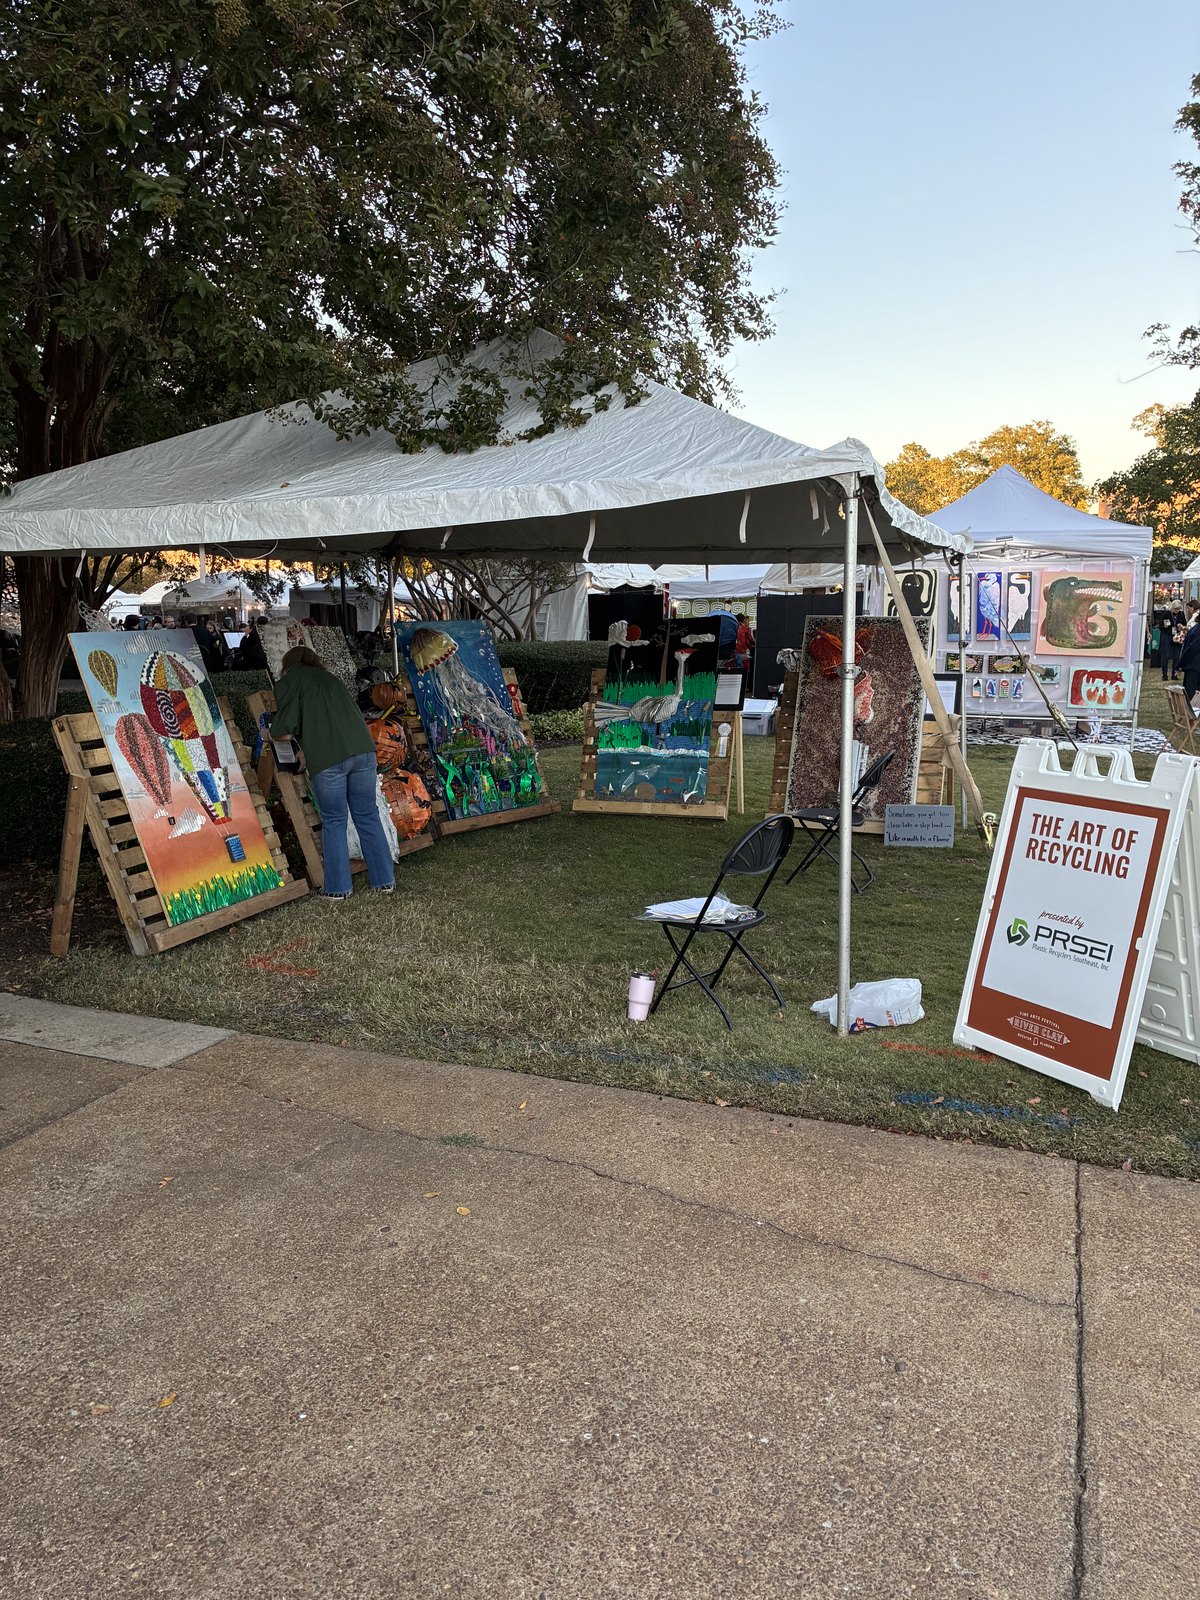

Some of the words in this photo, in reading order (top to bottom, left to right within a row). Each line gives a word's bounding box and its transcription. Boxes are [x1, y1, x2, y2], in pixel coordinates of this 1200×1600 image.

[920, 822, 931, 830] step
[1031, 813, 1064, 839] THE
[1067, 820, 1107, 847] ART
[1111, 827, 1139, 852] OF
[1025, 837, 1130, 879] RECYCLING
[1038, 910, 1076, 925] presented
[1074, 916, 1085, 930] by
[1032, 942, 1048, 954] Plastic
[1048, 946, 1072, 961] Recyclers
[1072, 955, 1100, 969] Southeast,
[1034, 925, 1114, 962] PRSEI
[1013, 1017, 1040, 1035] RIVER
[1041, 1027, 1064, 1042] CLAY
[1029, 1013, 1041, 1021] ARTS
[1041, 1016, 1060, 1030] FESTIVAL
